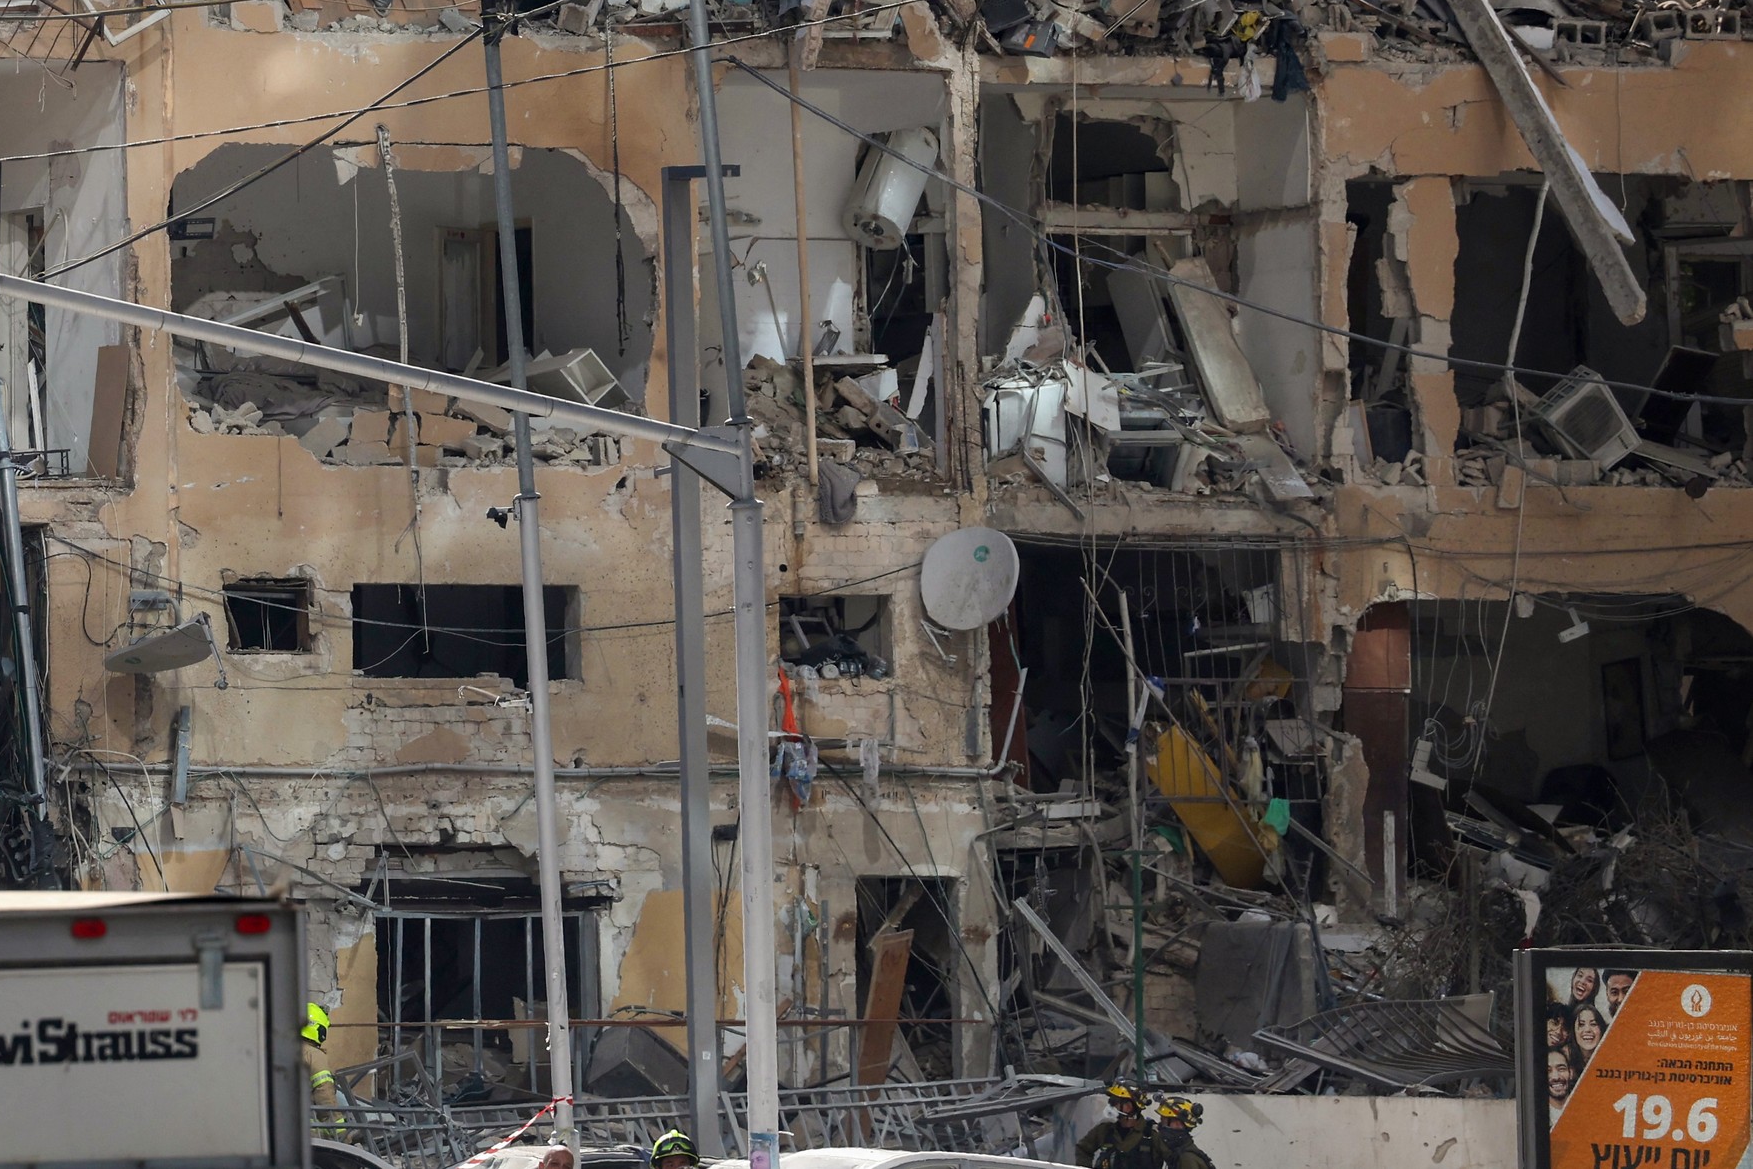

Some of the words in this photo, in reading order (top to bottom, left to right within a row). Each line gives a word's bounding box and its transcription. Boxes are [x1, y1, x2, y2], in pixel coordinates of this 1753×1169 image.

[1657, 1058, 1692, 1070] הבאה:
[1695, 1060, 1734, 1072] התחנה
[1596, 1068, 1622, 1079] בנגב
[1668, 1072, 1733, 1085] אוניברסיטת
[1613, 1093, 1718, 1143] 19.6
[1670, 1147, 1711, 1169] יום
